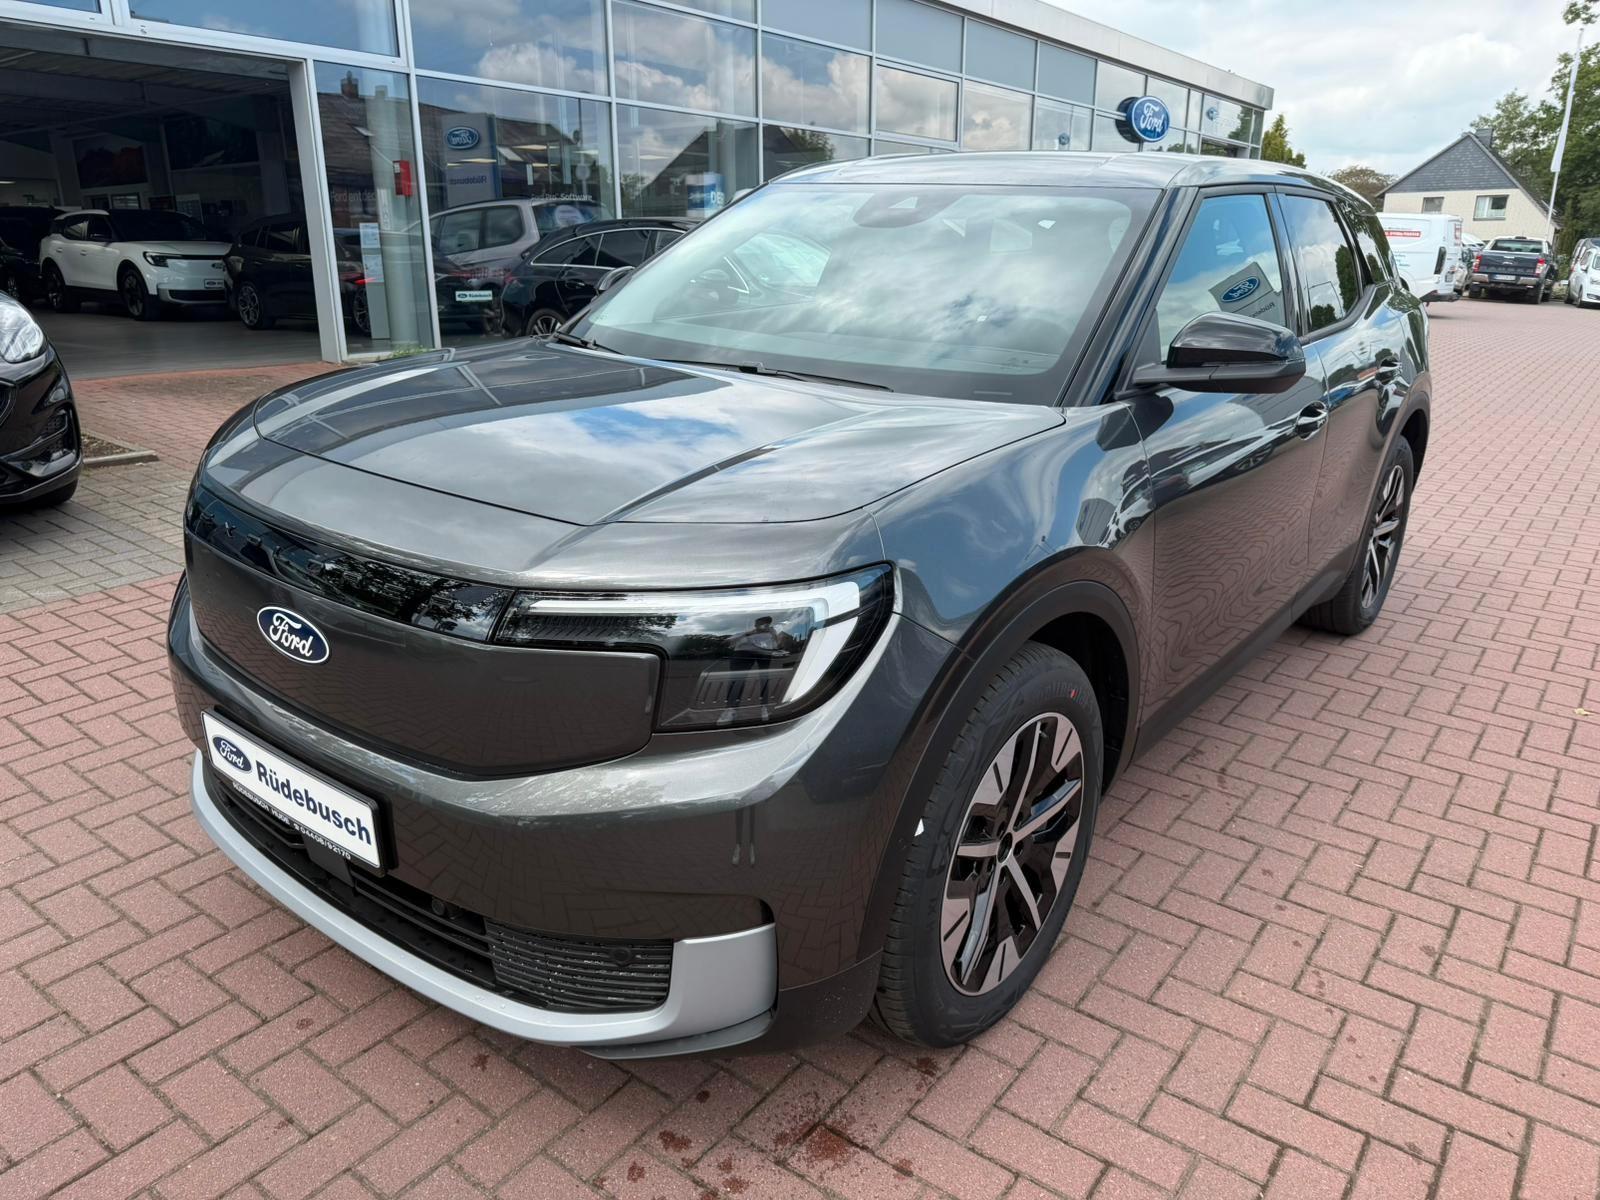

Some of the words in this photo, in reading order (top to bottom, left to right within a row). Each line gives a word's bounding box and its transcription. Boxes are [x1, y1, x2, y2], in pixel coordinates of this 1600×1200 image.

[1140, 102, 1166, 132] Ford
[268, 611, 314, 659] Ford
[218, 739, 246, 770] Ford
[255, 759, 372, 845] Rüdebusch
